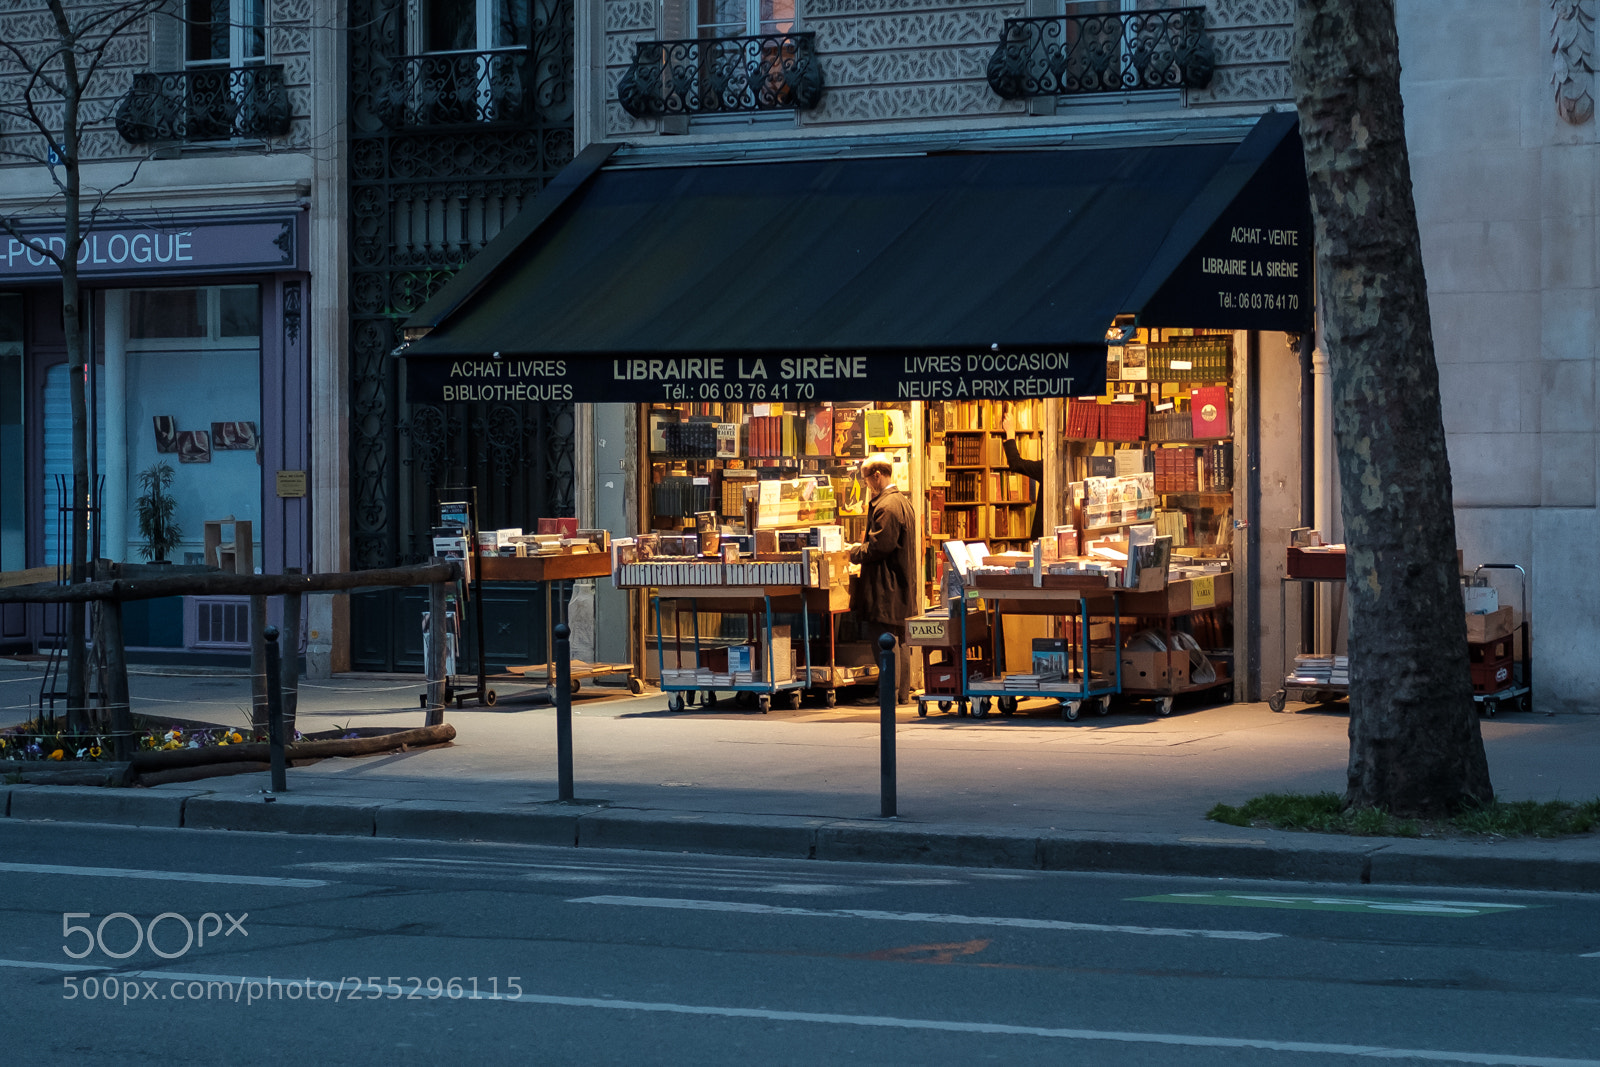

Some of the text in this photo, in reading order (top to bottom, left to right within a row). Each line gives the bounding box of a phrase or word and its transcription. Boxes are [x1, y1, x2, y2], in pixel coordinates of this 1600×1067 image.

[1230, 226, 1261, 244] ACHAT
[1268, 229, 1298, 246] VENTE
[1202, 257, 1298, 278] LIBRAIRIE LA SIRÈNE
[1239, 292, 1250, 309] 06
[1251, 293, 1262, 309] 03
[1264, 293, 1274, 309] 76
[1275, 294, 1286, 310] 41
[1288, 294, 1298, 310] 70
[450, 360, 567, 377] ACHAT LIVRES
[613, 354, 867, 380] LIBRAIRIE LA SIRÈNE
[904, 355, 962, 373] LIVRES
[443, 381, 573, 401] BIBLIOTHÈQUES
[662, 383, 815, 400] Tél.: 06 03 76 41 70
[898, 375, 1075, 398] NEUFS À PRIX RÉDUIT
[911, 625, 944, 635] PARIS
